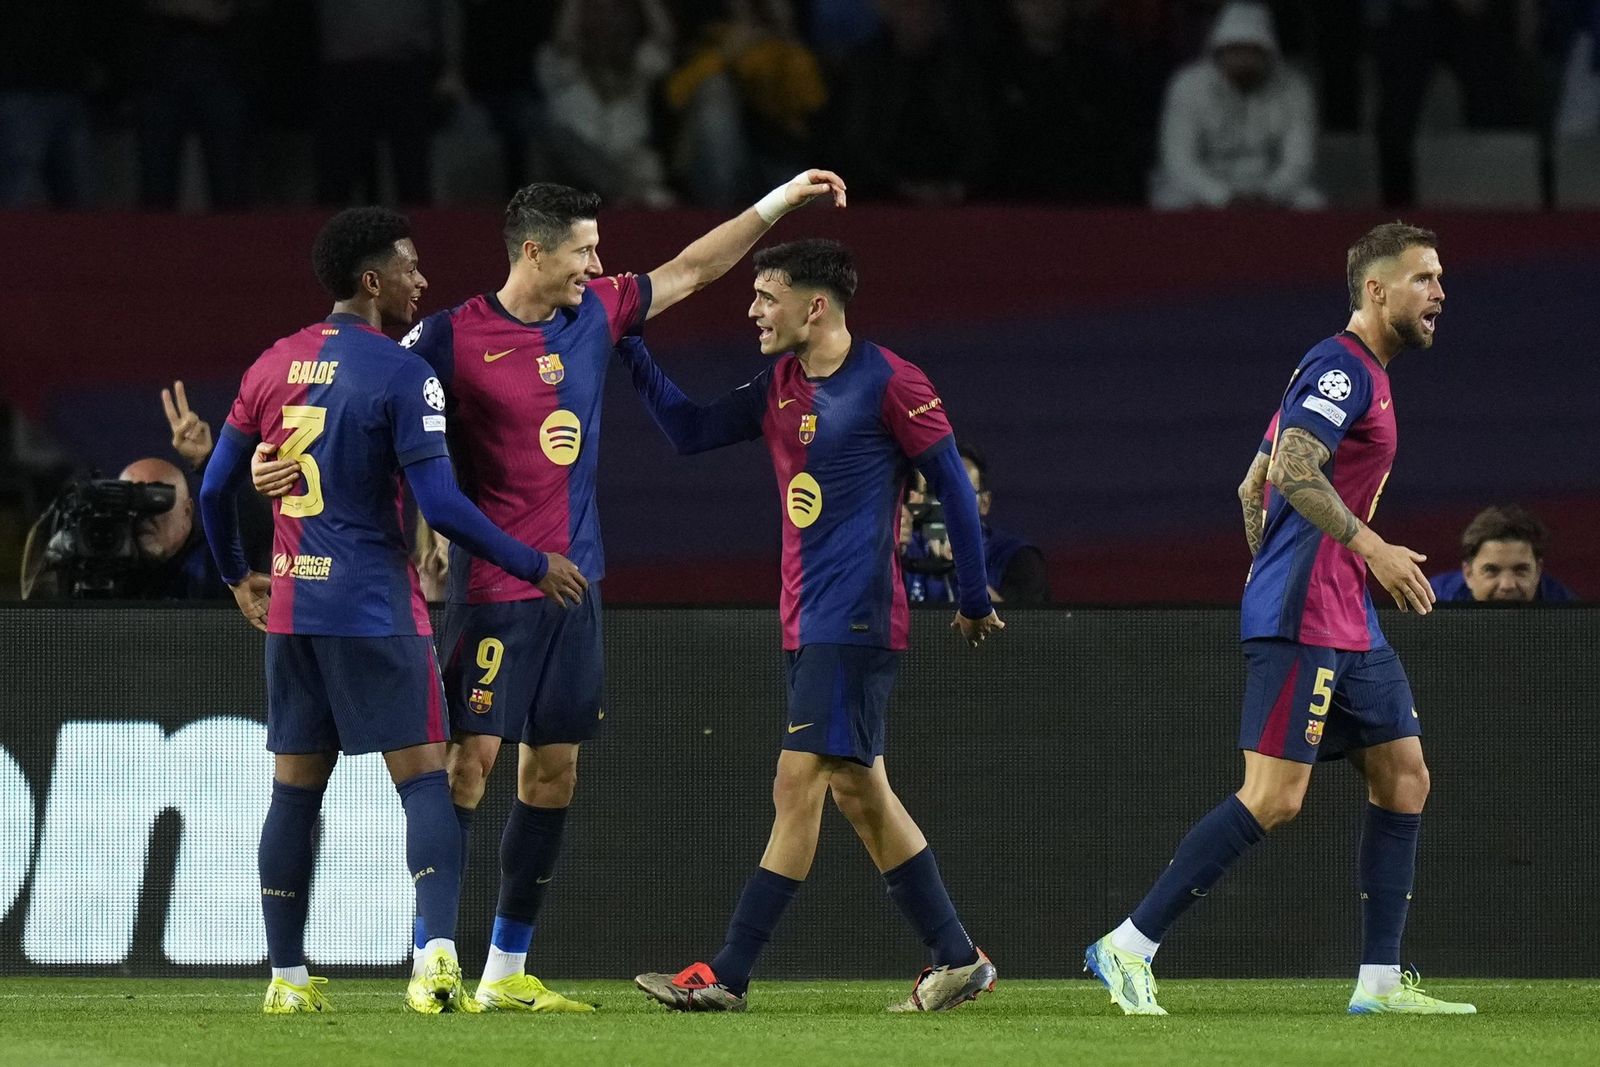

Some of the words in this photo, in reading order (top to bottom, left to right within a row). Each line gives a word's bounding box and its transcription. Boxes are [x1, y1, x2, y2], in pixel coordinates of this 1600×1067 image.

[287, 360, 339, 384] BALDE
[277, 405, 328, 518] 3
[289, 565, 331, 577] ACNUR
[294, 555, 333, 567] UNHCR
[476, 637, 505, 685] 9
[1308, 667, 1335, 716] 5
